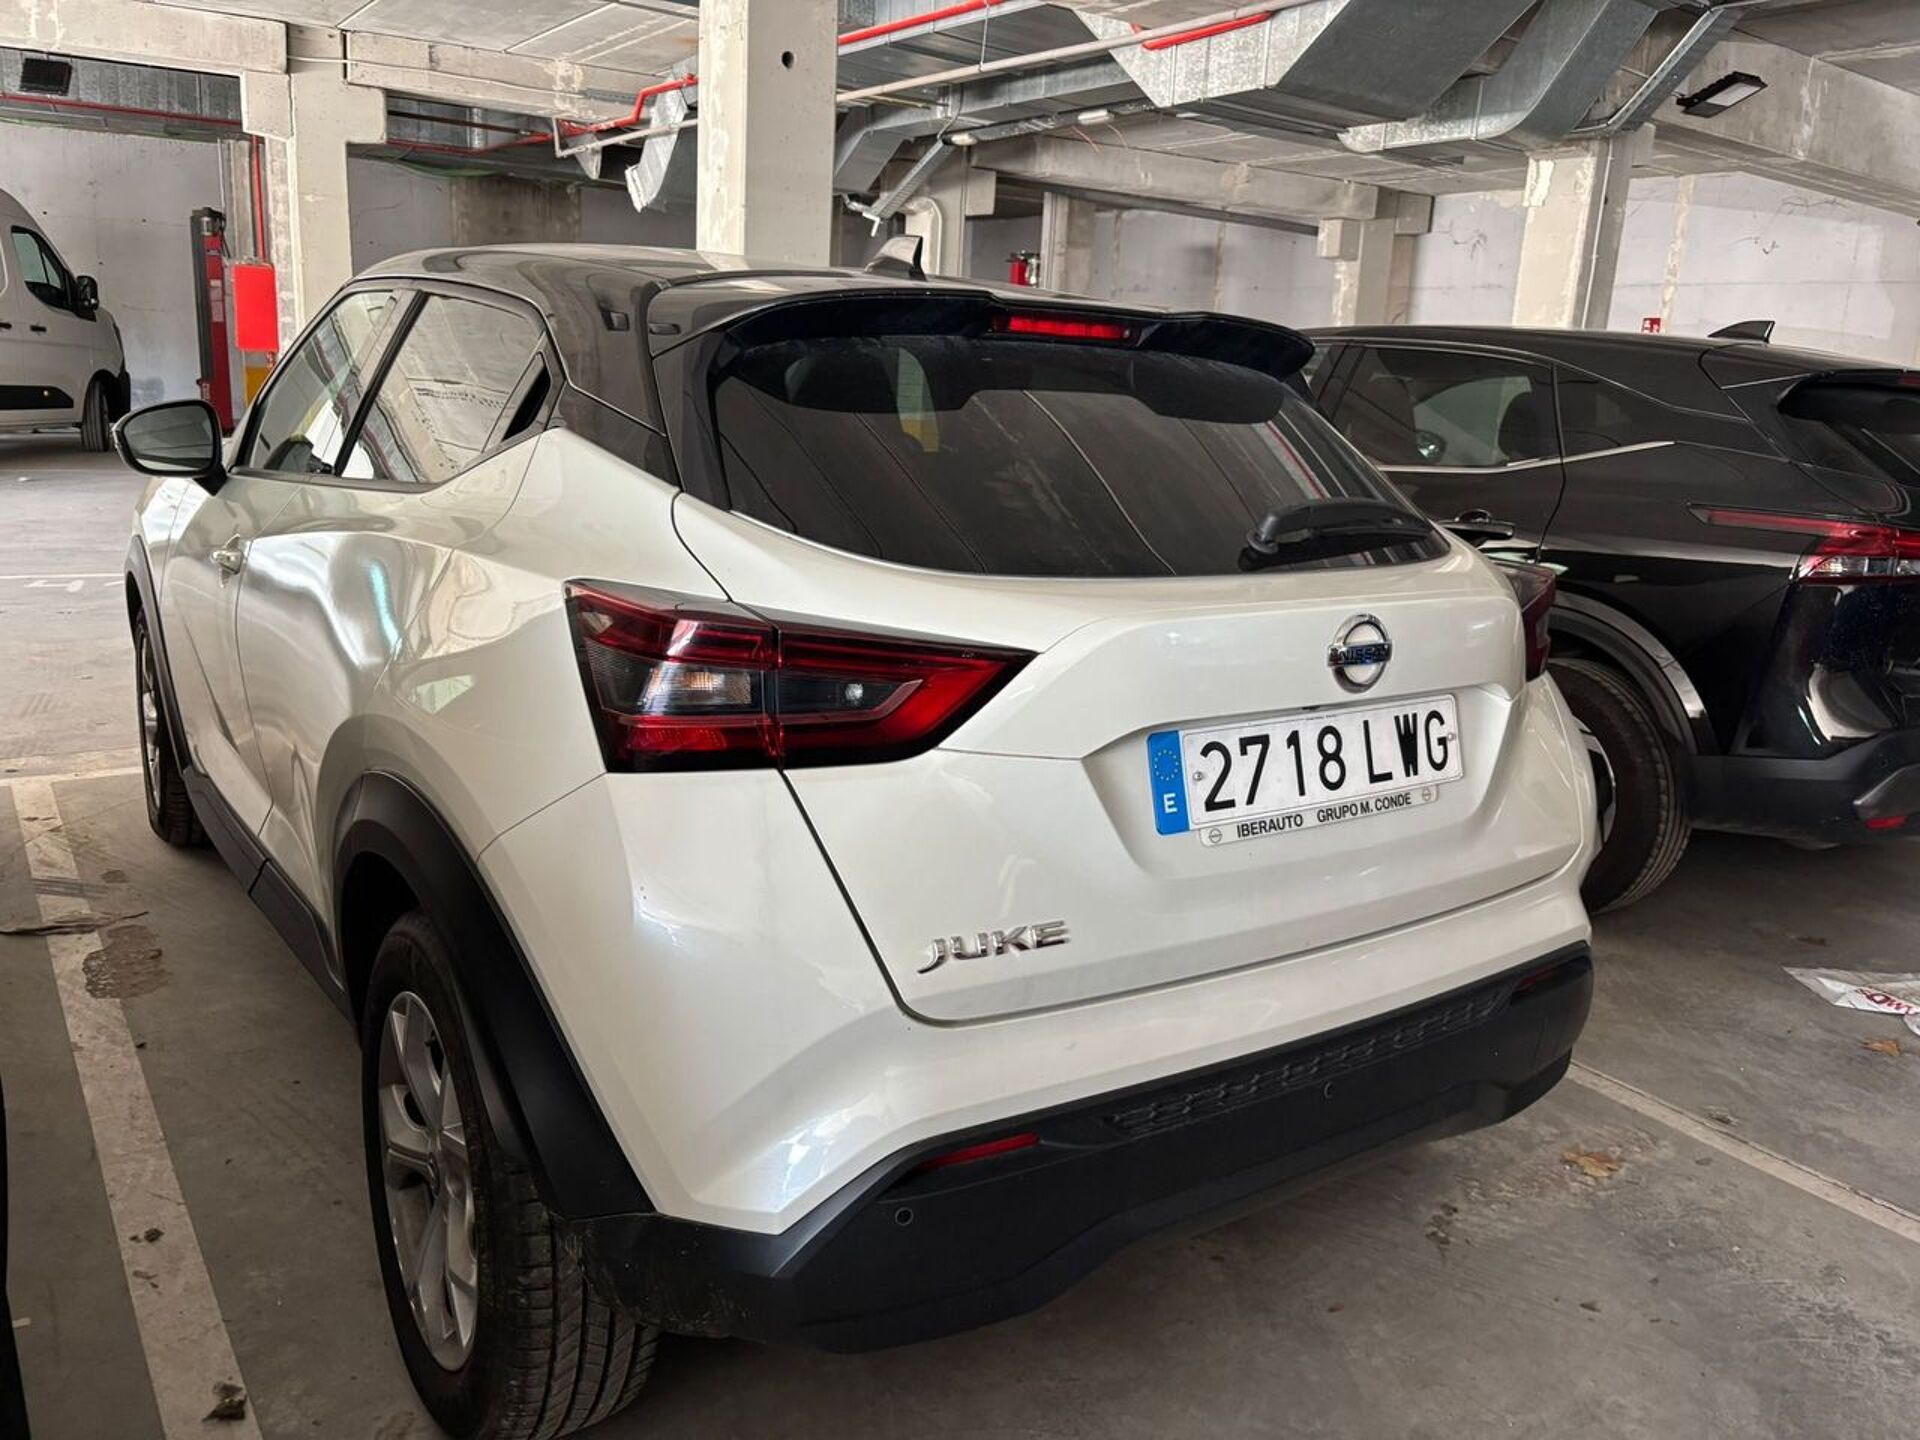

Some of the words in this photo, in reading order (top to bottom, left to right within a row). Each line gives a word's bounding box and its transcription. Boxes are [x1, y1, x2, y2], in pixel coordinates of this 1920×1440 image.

[1200, 725, 1347, 812] 2718
[1363, 710, 1449, 784] LWG
[1164, 793, 1178, 813] E
[1236, 813, 1304, 838] IBERAUTO
[1317, 802, 1359, 823] GRUPO
[1360, 800, 1374, 816] M.
[1375, 793, 1412, 811] CONDE
[917, 920, 1071, 974] JUKE
